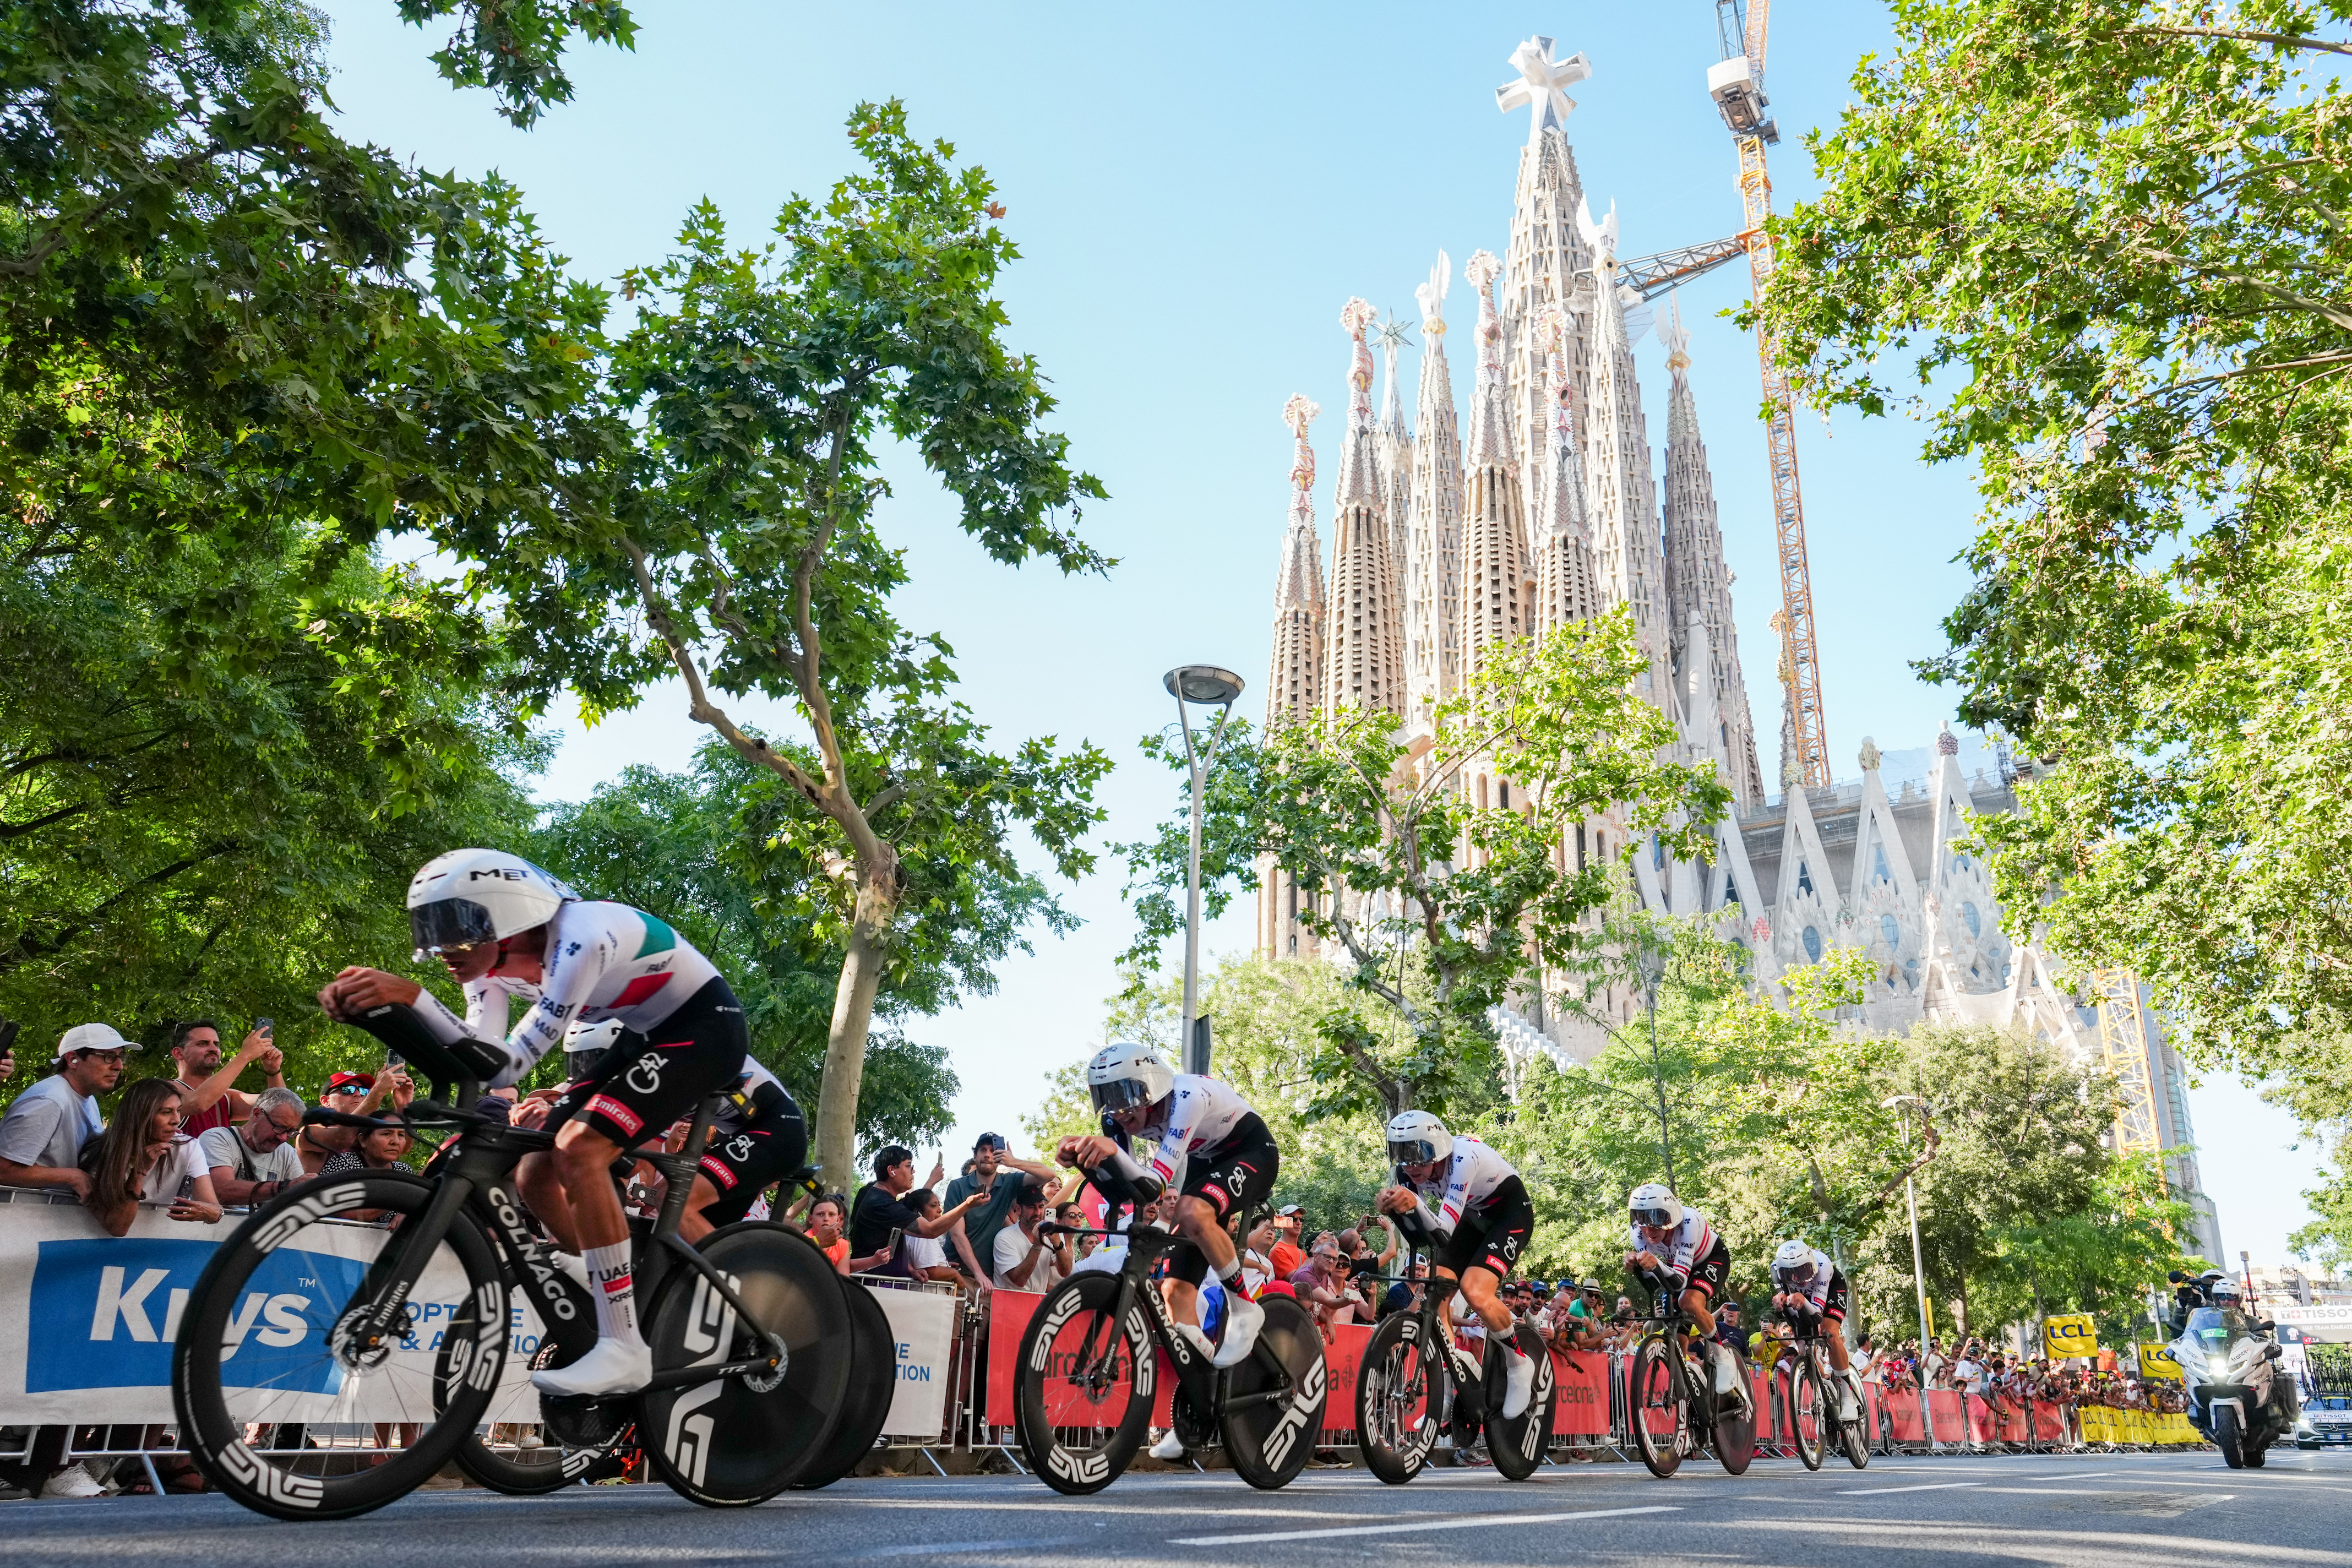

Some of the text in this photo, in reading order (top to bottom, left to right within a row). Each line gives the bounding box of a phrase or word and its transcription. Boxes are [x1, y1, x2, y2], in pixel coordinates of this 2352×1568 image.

[470, 869, 529, 881] MET
[539, 997, 576, 1022] FAB1
[625, 1052, 669, 1093] G42
[590, 1097, 637, 1131] Emirates
[1168, 1126, 1192, 1142] FAB1
[725, 1135, 755, 1162] G42
[700, 1157, 733, 1185] Emirates
[1228, 1167, 1246, 1197] G42
[1451, 1182, 1468, 1193] FAB1
[1446, 1194, 1463, 1207] L'IMAD
[488, 1187, 576, 1320] COLNAGO
[1504, 1236, 1517, 1261] G42
[598, 1262, 630, 1281] UAE
[1705, 1264, 1717, 1282] G42
[374, 1280, 409, 1327] Emirates
[1145, 1278, 1190, 1365] COLNAGO
[2049, 1324, 2092, 1339] LCL
[1102, 1342, 1117, 1375] Emirates
[1436, 1315, 1466, 1383] COLNAGO
[2147, 1351, 2173, 1362] LC
[1413, 1368, 1422, 1392] Emirates
[1676, 1340, 1700, 1397] COLNAGO
[1556, 1381, 1594, 1404] rcelona
[2083, 1412, 2096, 1424] LCL
